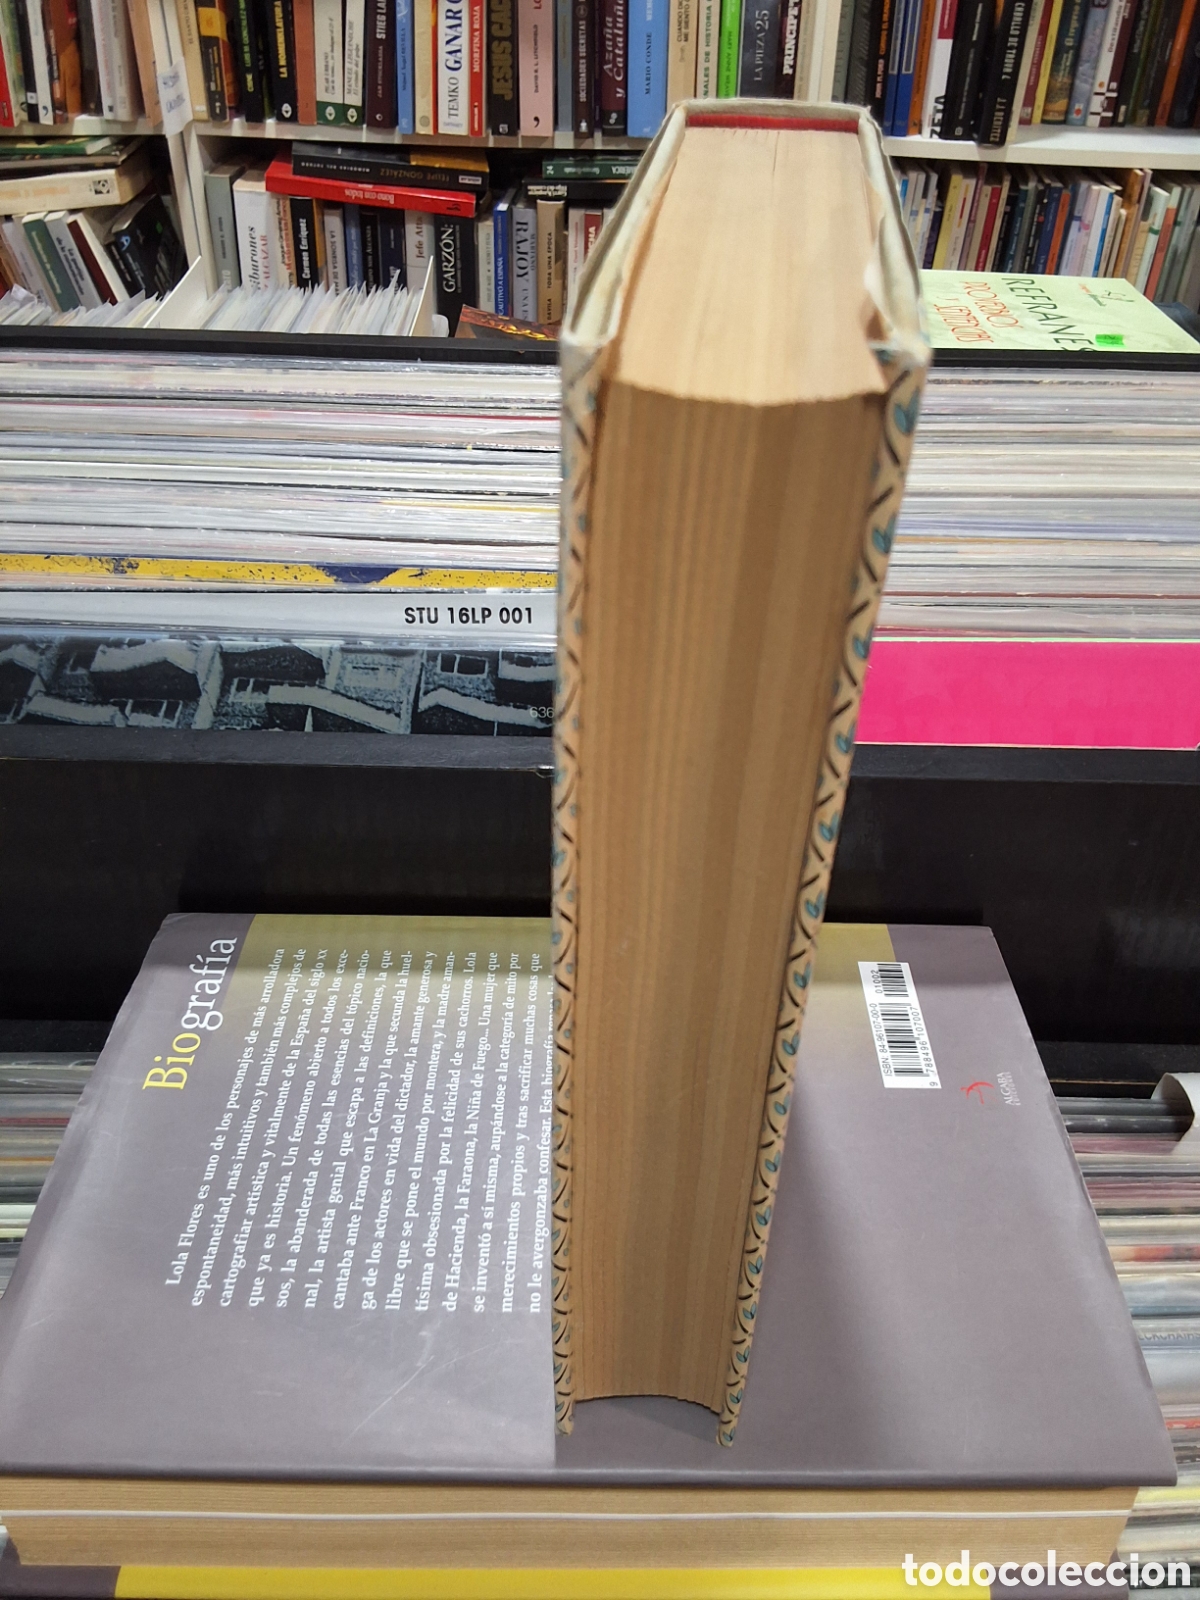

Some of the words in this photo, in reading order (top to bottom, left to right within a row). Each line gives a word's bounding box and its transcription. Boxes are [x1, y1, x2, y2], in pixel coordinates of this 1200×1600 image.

[375, 14, 386, 39] STIEG
[704, 5, 712, 48] HISTORIA
[754, 10, 769, 30] 25
[1010, 2, 1025, 35] CABALLO
[444, 8, 462, 72] GANAR
[578, 20, 587, 57] SECRETAS
[602, 16, 613, 76] Azaña
[683, 32, 689, 43] ME
[754, 32, 766, 64] PIEZA
[1007, 37, 1018, 47] DE
[703, 50, 711, 63] DE
[1003, 49, 1016, 73] TROYA
[279, 67, 288, 78] LA
[491, 41, 513, 101] JESUS
[578, 59, 587, 102] SOCIEDADES
[702, 66, 710, 99] NALES
[753, 67, 763, 81] LA
[447, 77, 459, 119] TEMKO
[615, 87, 626, 98] y
[929, 95, 945, 139] ZETA
[427, 173, 450, 182] FELIPE
[344, 189, 364, 200] todos
[377, 193, 395, 204] Bono
[330, 230, 336, 239] LA
[415, 241, 425, 259] Jefe
[439, 223, 456, 293] GARZÓN:
[515, 220, 530, 282] RAJOY
[301, 252, 311, 279] Carmen
[332, 271, 339, 280] DE
[495, 257, 504, 280] ESPAÑA
[496, 285, 505, 315] CAUTIVO
[404, 606, 440, 626] STU
[447, 607, 492, 626] 16LP
[499, 607, 534, 626] 001
[293, 948, 307, 961] de
[336, 949, 349, 974] exce-
[397, 950, 413, 976] huel-
[463, 952, 477, 973] Lola
[530, 953, 543, 972] que
[260, 948, 285, 1004] arrolladora
[308, 962, 325, 987] siglo
[327, 976, 343, 992] los
[394, 978, 408, 988] la
[871, 969, 884, 994] 01002
[279, 962, 303, 1015] complejos
[302, 989, 318, 1006] del
[528, 975, 539, 1002] cosas
[142, 937, 237, 1091] Biografía
[320, 994, 338, 1024] todos
[389, 989, 406, 1032] secunda
[457, 976, 474, 1028] cachorros.
[252, 1005, 267, 1028] más
[272, 1015, 287, 1038] más
[289, 1008, 312, 1046] España
[522, 1004, 536, 1045] muchas
[869, 1003, 888, 1054] 84-96107-00-0
[910, 1007, 924, 1037] 107007
[244, 1029, 260, 1044] de
[320, 1026, 330, 1034] a
[455, 1030, 467, 1049] sus
[285, 1049, 301, 1060] la
[306, 1036, 327, 1077] abierto
[384, 1034, 398, 1056] que
[254, 1039, 280, 1087] también
[281, 1062, 297, 1078] de
[377, 1058, 393, 1069] la
[449, 1051, 464, 1066] de
[882, 1055, 893, 1077] ISBN:
[921, 1041, 935, 1076] 788496
[225, 1046, 254, 1110] personajes
[379, 1071, 393, 1079] y
[518, 1048, 533, 1102] sacrificar
[254, 1088, 269, 1097] y
[440, 1069, 461, 1123] felicidad
[997, 1072, 1013, 1105] ALGABA
[263, 1079, 292, 1147] vitalmente
[287, 1080, 316, 1143] fenómeno
[367, 1081, 390, 1124] Granja
[215, 1112, 234, 1131] los
[231, 1098, 263, 1161] intuitivos
[515, 1105, 529, 1129] tras
[210, 1134, 227, 1151] de
[363, 1126, 379, 1143] La
[438, 1126, 453, 1138] la
[516, 1132, 530, 1141] y
[261, 1149, 277, 1158] y
[280, 1146, 300, 1167] Un
[363, 1145, 376, 1163] en
[438, 1141, 453, 1165] por
[202, 1154, 220, 1181] uno
[226, 1162, 243, 1191] más
[510, 1144, 528, 1197] propios
[197, 1184, 211, 1200] es
[245, 1161, 270, 1216] artística
[264, 1171, 293, 1229] historia.
[348, 1164, 372, 1211] Franco
[177, 1203, 205, 1247] Flores
[422, 1168, 448, 1258] obsesionada
[263, 1232, 277, 1250] es
[345, 1214, 362, 1247] ante
[191, 1192, 237, 1307] espontaneidad,
[219, 1218, 254, 1307] cartografiar
[501, 1201, 521, 1313] merecimientos
[165, 1251, 190, 1285] Lola
[256, 1253, 273, 1273] ya
[248, 1276, 266, 1307] que
[333, 1249, 355, 1310] cantaba
[414, 1262, 435, 1312] tísima
